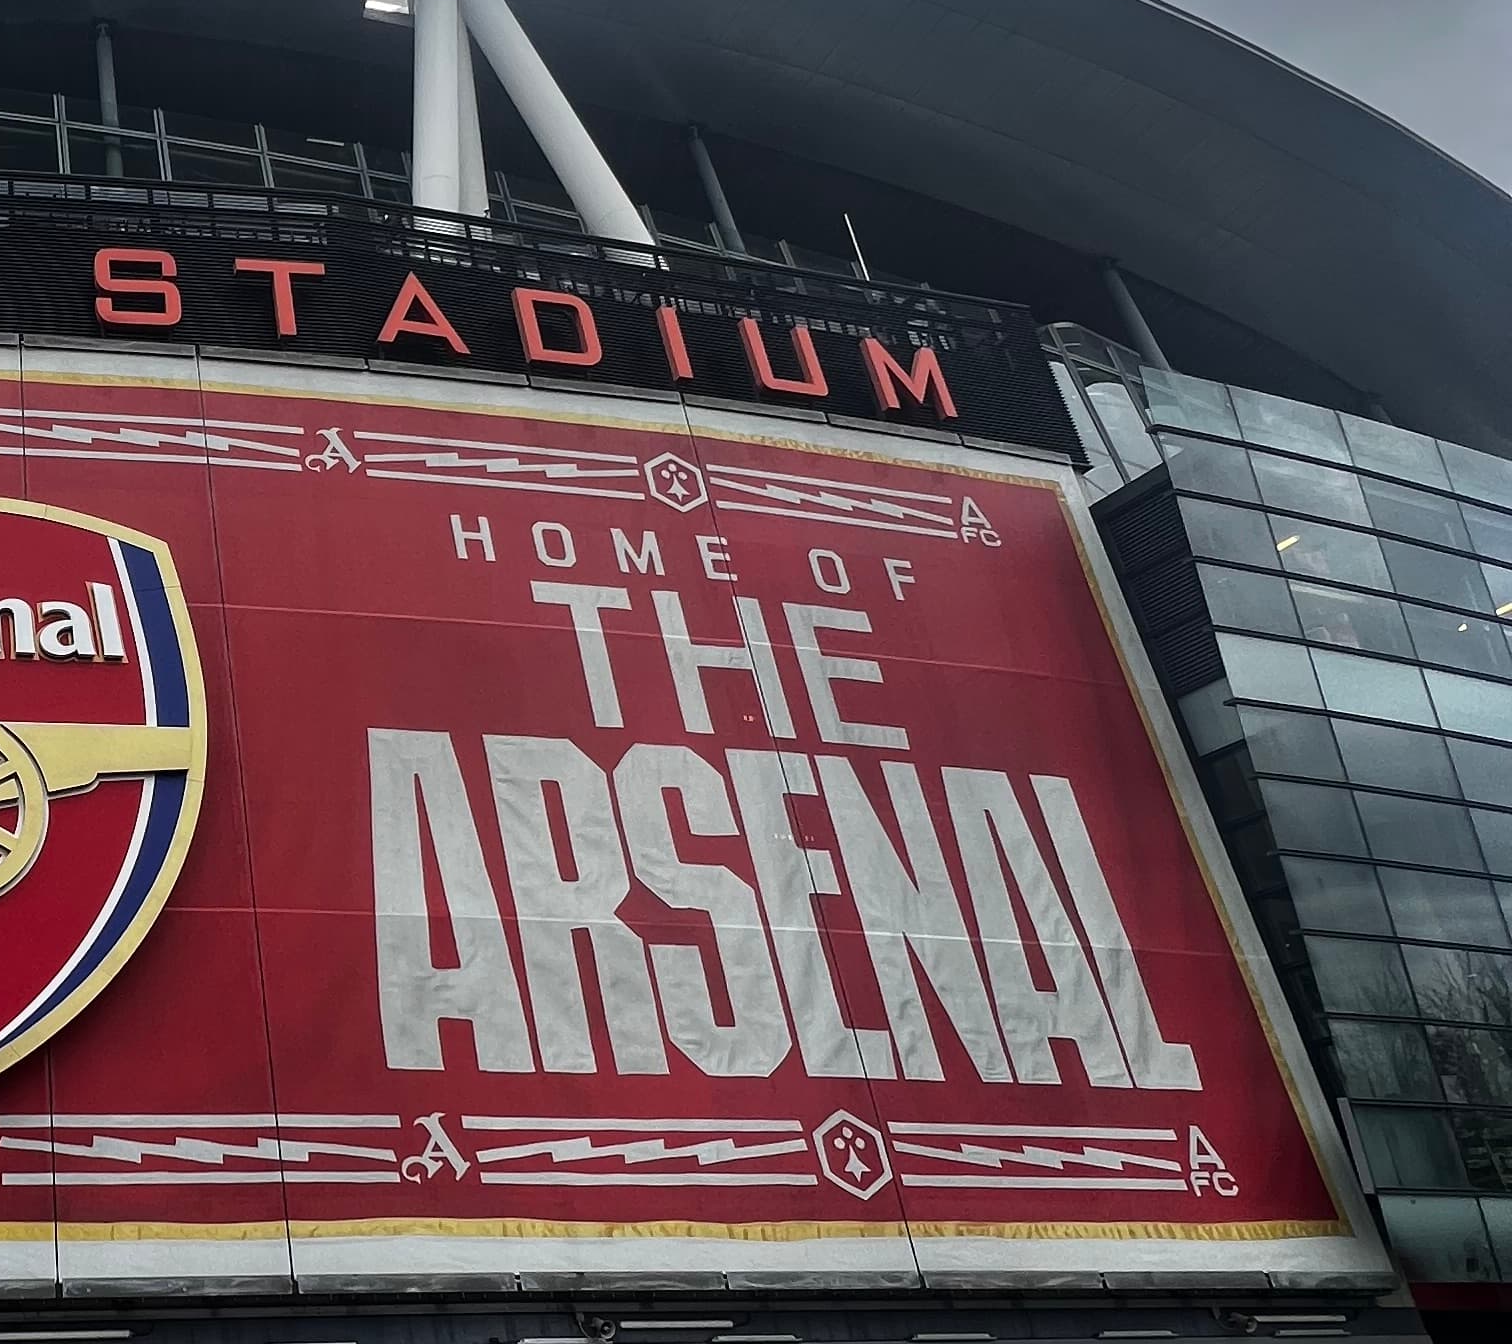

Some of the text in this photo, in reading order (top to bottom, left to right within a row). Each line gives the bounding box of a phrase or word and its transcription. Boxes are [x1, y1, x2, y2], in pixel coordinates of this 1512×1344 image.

[93, 247, 959, 419] STADIUM
[449, 513, 916, 601] HOME OF
[530, 580, 910, 752] THE
[368, 727, 1203, 1091] ARSENAL
